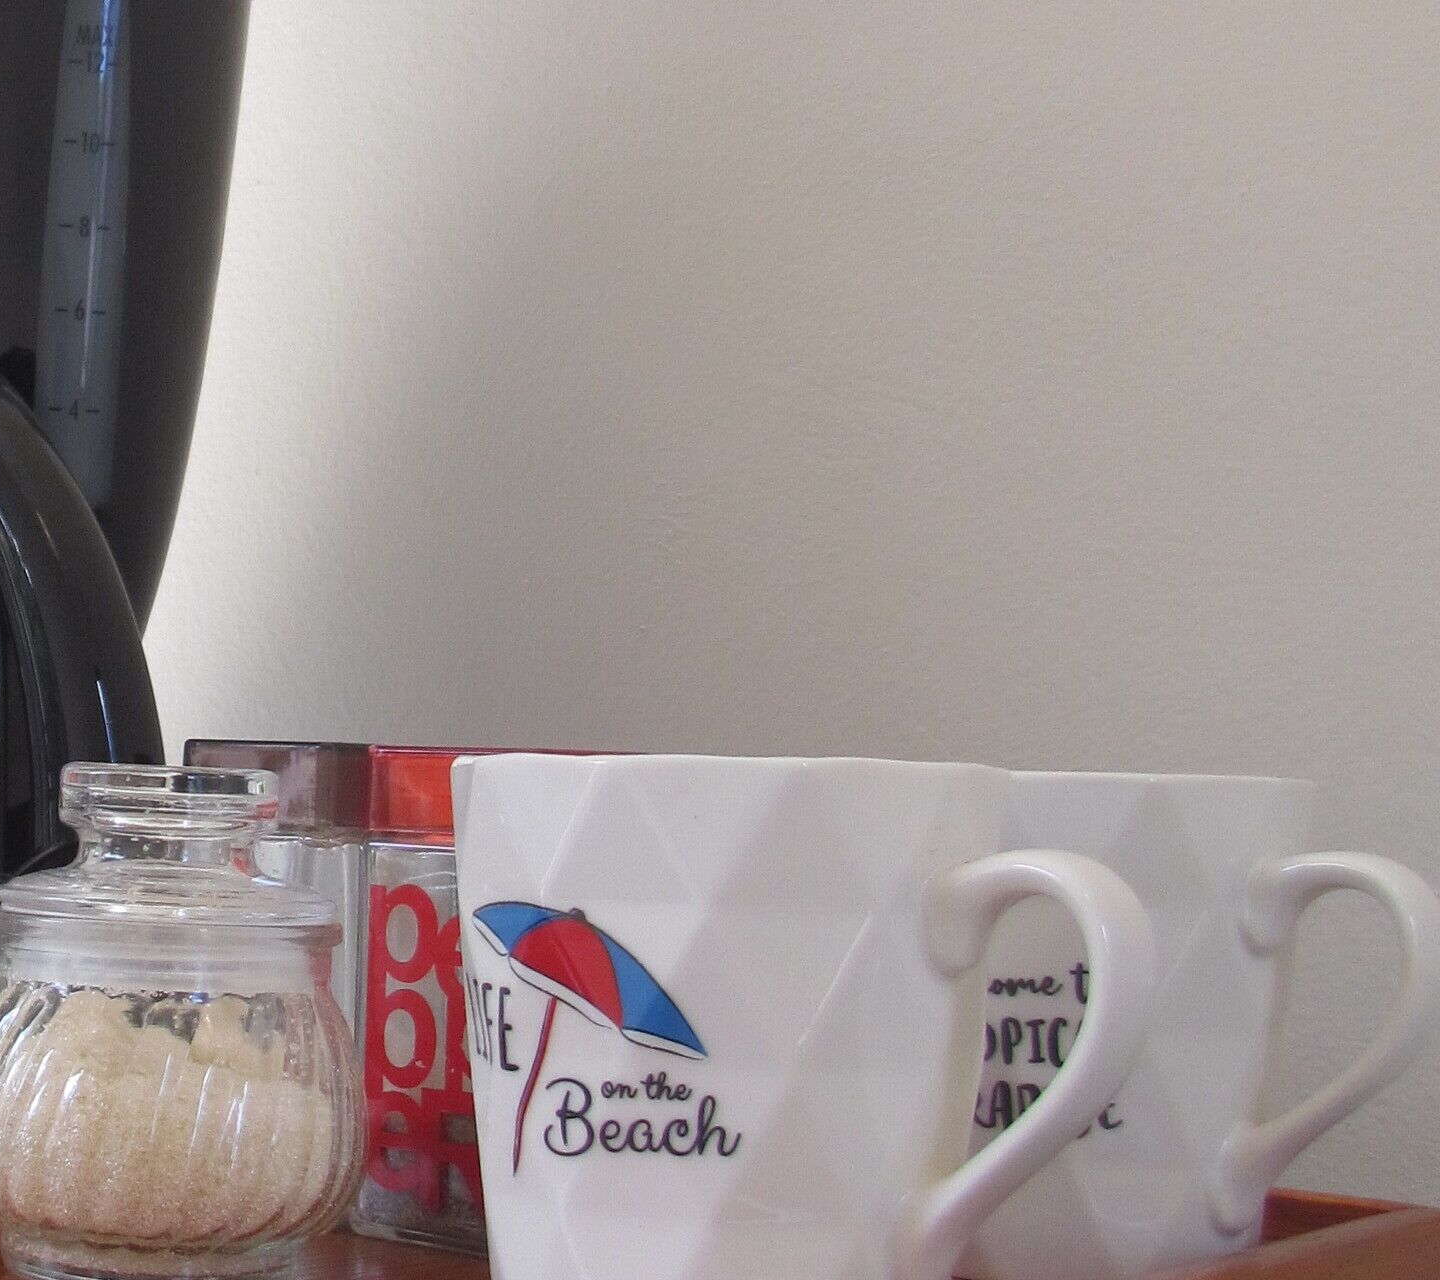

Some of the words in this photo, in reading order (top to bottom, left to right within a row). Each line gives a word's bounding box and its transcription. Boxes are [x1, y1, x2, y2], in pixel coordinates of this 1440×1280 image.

[68, 399, 79, 419] 4
[600, 1080, 637, 1100] on
[640, 1071, 692, 1101] the
[543, 1077, 742, 1157] Beach
